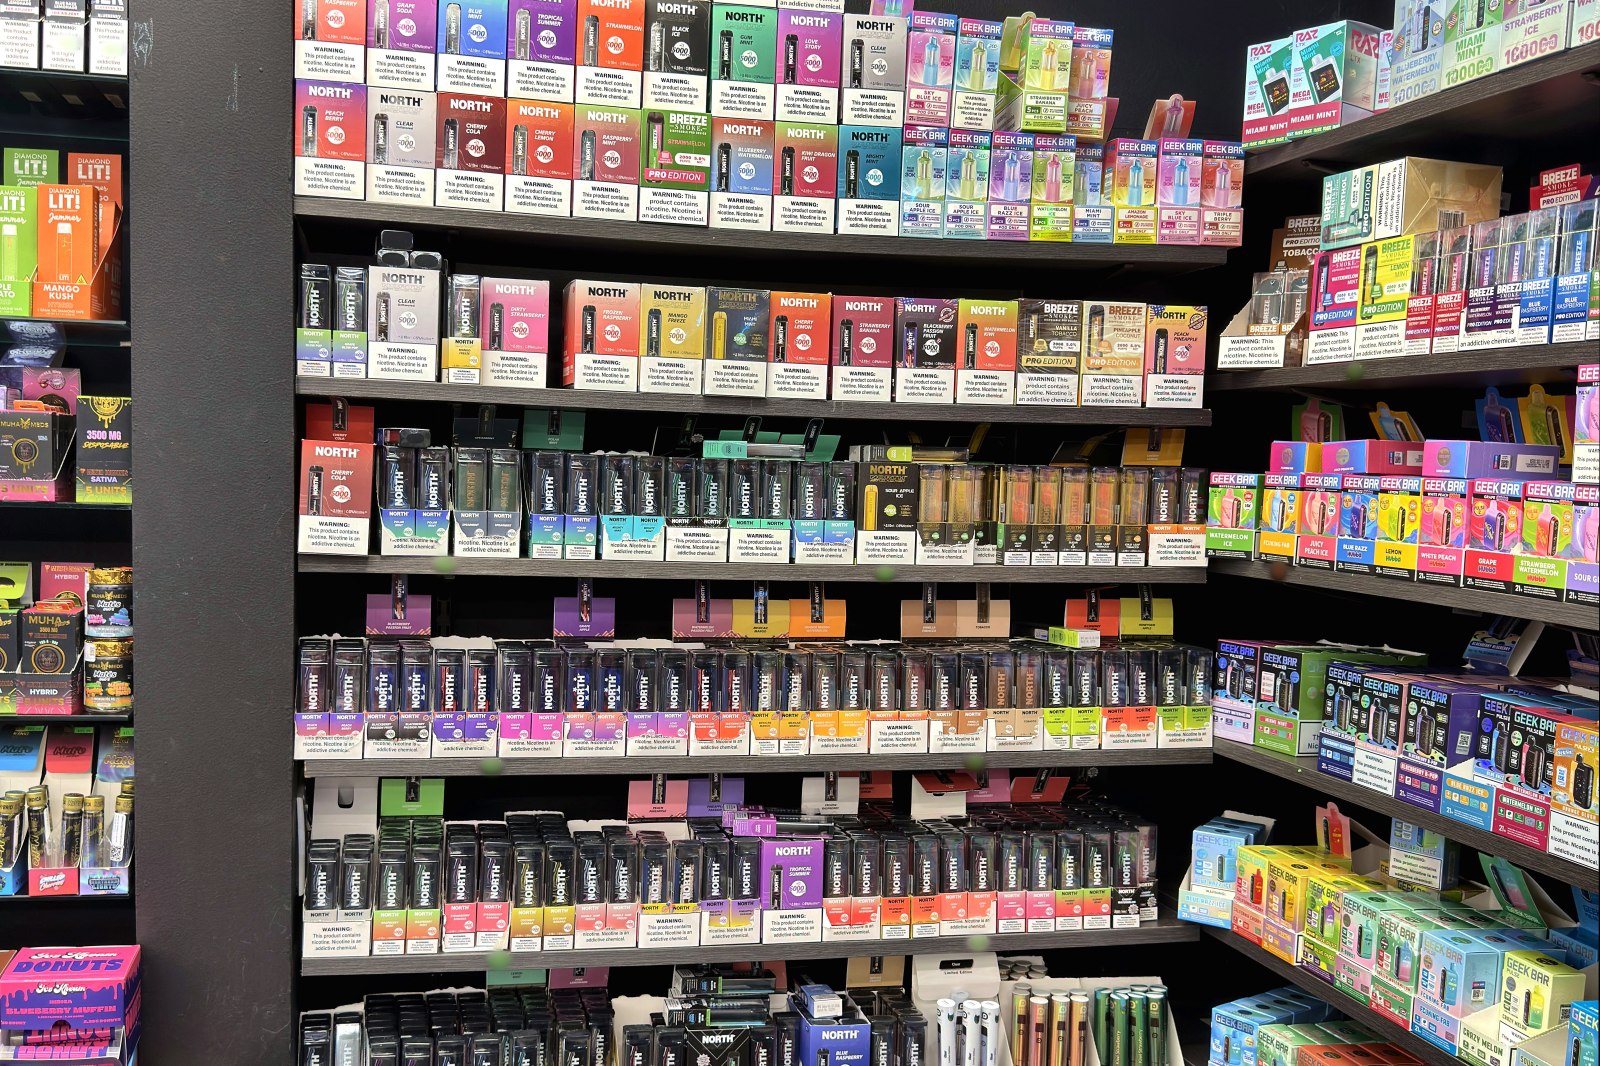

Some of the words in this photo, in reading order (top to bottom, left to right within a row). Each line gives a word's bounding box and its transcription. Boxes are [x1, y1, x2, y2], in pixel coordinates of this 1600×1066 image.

[657, 2, 697, 15] NORTH
[537, 13, 563, 21] TROPICAL
[726, 12, 762, 23] NORTH
[914, 16, 935, 27] GEEK
[937, 17, 955, 28] BAR
[1504, 4, 1564, 32] STRAWBERRY
[606, 23, 642, 32] STRAWMELON
[1032, 23, 1052, 33] GEEK
[1054, 24, 1072, 34] BAR
[1524, 23, 1538, 36] ICE
[1295, 30, 1318, 43] RAZ
[1456, 32, 1486, 52] MIAMI
[1457, 44, 1483, 62] MINT
[1397, 52, 1437, 73] BLUEBERRY
[1392, 62, 1440, 85] WATERMELON
[309, 86, 350, 98] NORTH
[1292, 91, 1311, 100] MEGA
[450, 100, 491, 112] NORTH
[670, 114, 707, 126] BREEZE
[1291, 113, 1313, 124] MIAMI
[1315, 110, 1337, 119] MINT
[534, 129, 555, 137] CHERRY
[788, 128, 824, 139] NORTH
[852, 132, 888, 142] NORTH
[906, 130, 926, 141] GEEK
[928, 131, 946, 141] BAR
[1119, 142, 1138, 152] GEEK
[1140, 143, 1156, 153] BAR
[14, 160, 47, 175] LIT!
[649, 170, 667, 179] PRO
[668, 172, 700, 180] EDITION
[1542, 168, 1578, 184] BREEZE
[652, 191, 683, 199] WARNING:
[1362, 175, 1371, 208] EDITION
[49, 194, 80, 210] LIT!
[1542, 196, 1553, 204] PRO
[1555, 192, 1578, 201] EDITION
[671, 200, 698, 208] contains
[646, 206, 670, 214] nicotine.
[48, 214, 81, 224] Jammer
[1382, 239, 1411, 253] BREEZE
[1332, 250, 1360, 263] BREEZE
[1390, 264, 1409, 272] LEMON
[382, 273, 422, 284] NORTH
[1395, 270, 1408, 278] MINT
[43, 284, 80, 292] MANGO
[496, 284, 534, 295] NORTH
[588, 287, 626, 297] NORTH
[49, 292, 73, 300] KUSH
[1044, 304, 1078, 314] BREEZE
[1557, 301, 1586, 309] RASPBERRY
[1315, 312, 1328, 322] PRO
[1329, 309, 1353, 320] EDITION
[87, 430, 107, 440] 3500
[109, 431, 121, 440] MG
[315, 446, 358, 458] NORTH
[870, 464, 905, 474] NORTH
[1212, 474, 1234, 484] GEEK
[1236, 475, 1255, 485] BAR
[1424, 479, 1444, 491] GEEK
[1446, 481, 1464, 492] BAR
[1475, 481, 1496, 493] GEEK
[1499, 482, 1519, 494] BAR
[1210, 532, 1248, 541] WATERMELON
[1519, 566, 1558, 576] WATERMELON
[29, 616, 60, 624] MUHA
[1263, 652, 1278, 664] GEEK
[1280, 655, 1297, 666] BAR
[445, 672, 454, 708] NORTH
[1411, 685, 1427, 698] GEEK
[1429, 690, 1447, 703] BAR
[1503, 795, 1534, 812] WATERMELON
[1534, 805, 1543, 815] ICE
[776, 847, 811, 856] NORTH
[457, 865, 466, 899] NORTH
[13, 959, 124, 972] DONUTS
[1507, 958, 1529, 977] GEEK
[1532, 969, 1549, 986] BAR
[73, 1006, 116, 1014] MUFFIN
[702, 1035, 734, 1044] NORTH
[822, 1031, 857, 1039] NORTH
[1463, 1027, 1480, 1043] CRAZY
[1482, 1039, 1502, 1056] MELON
